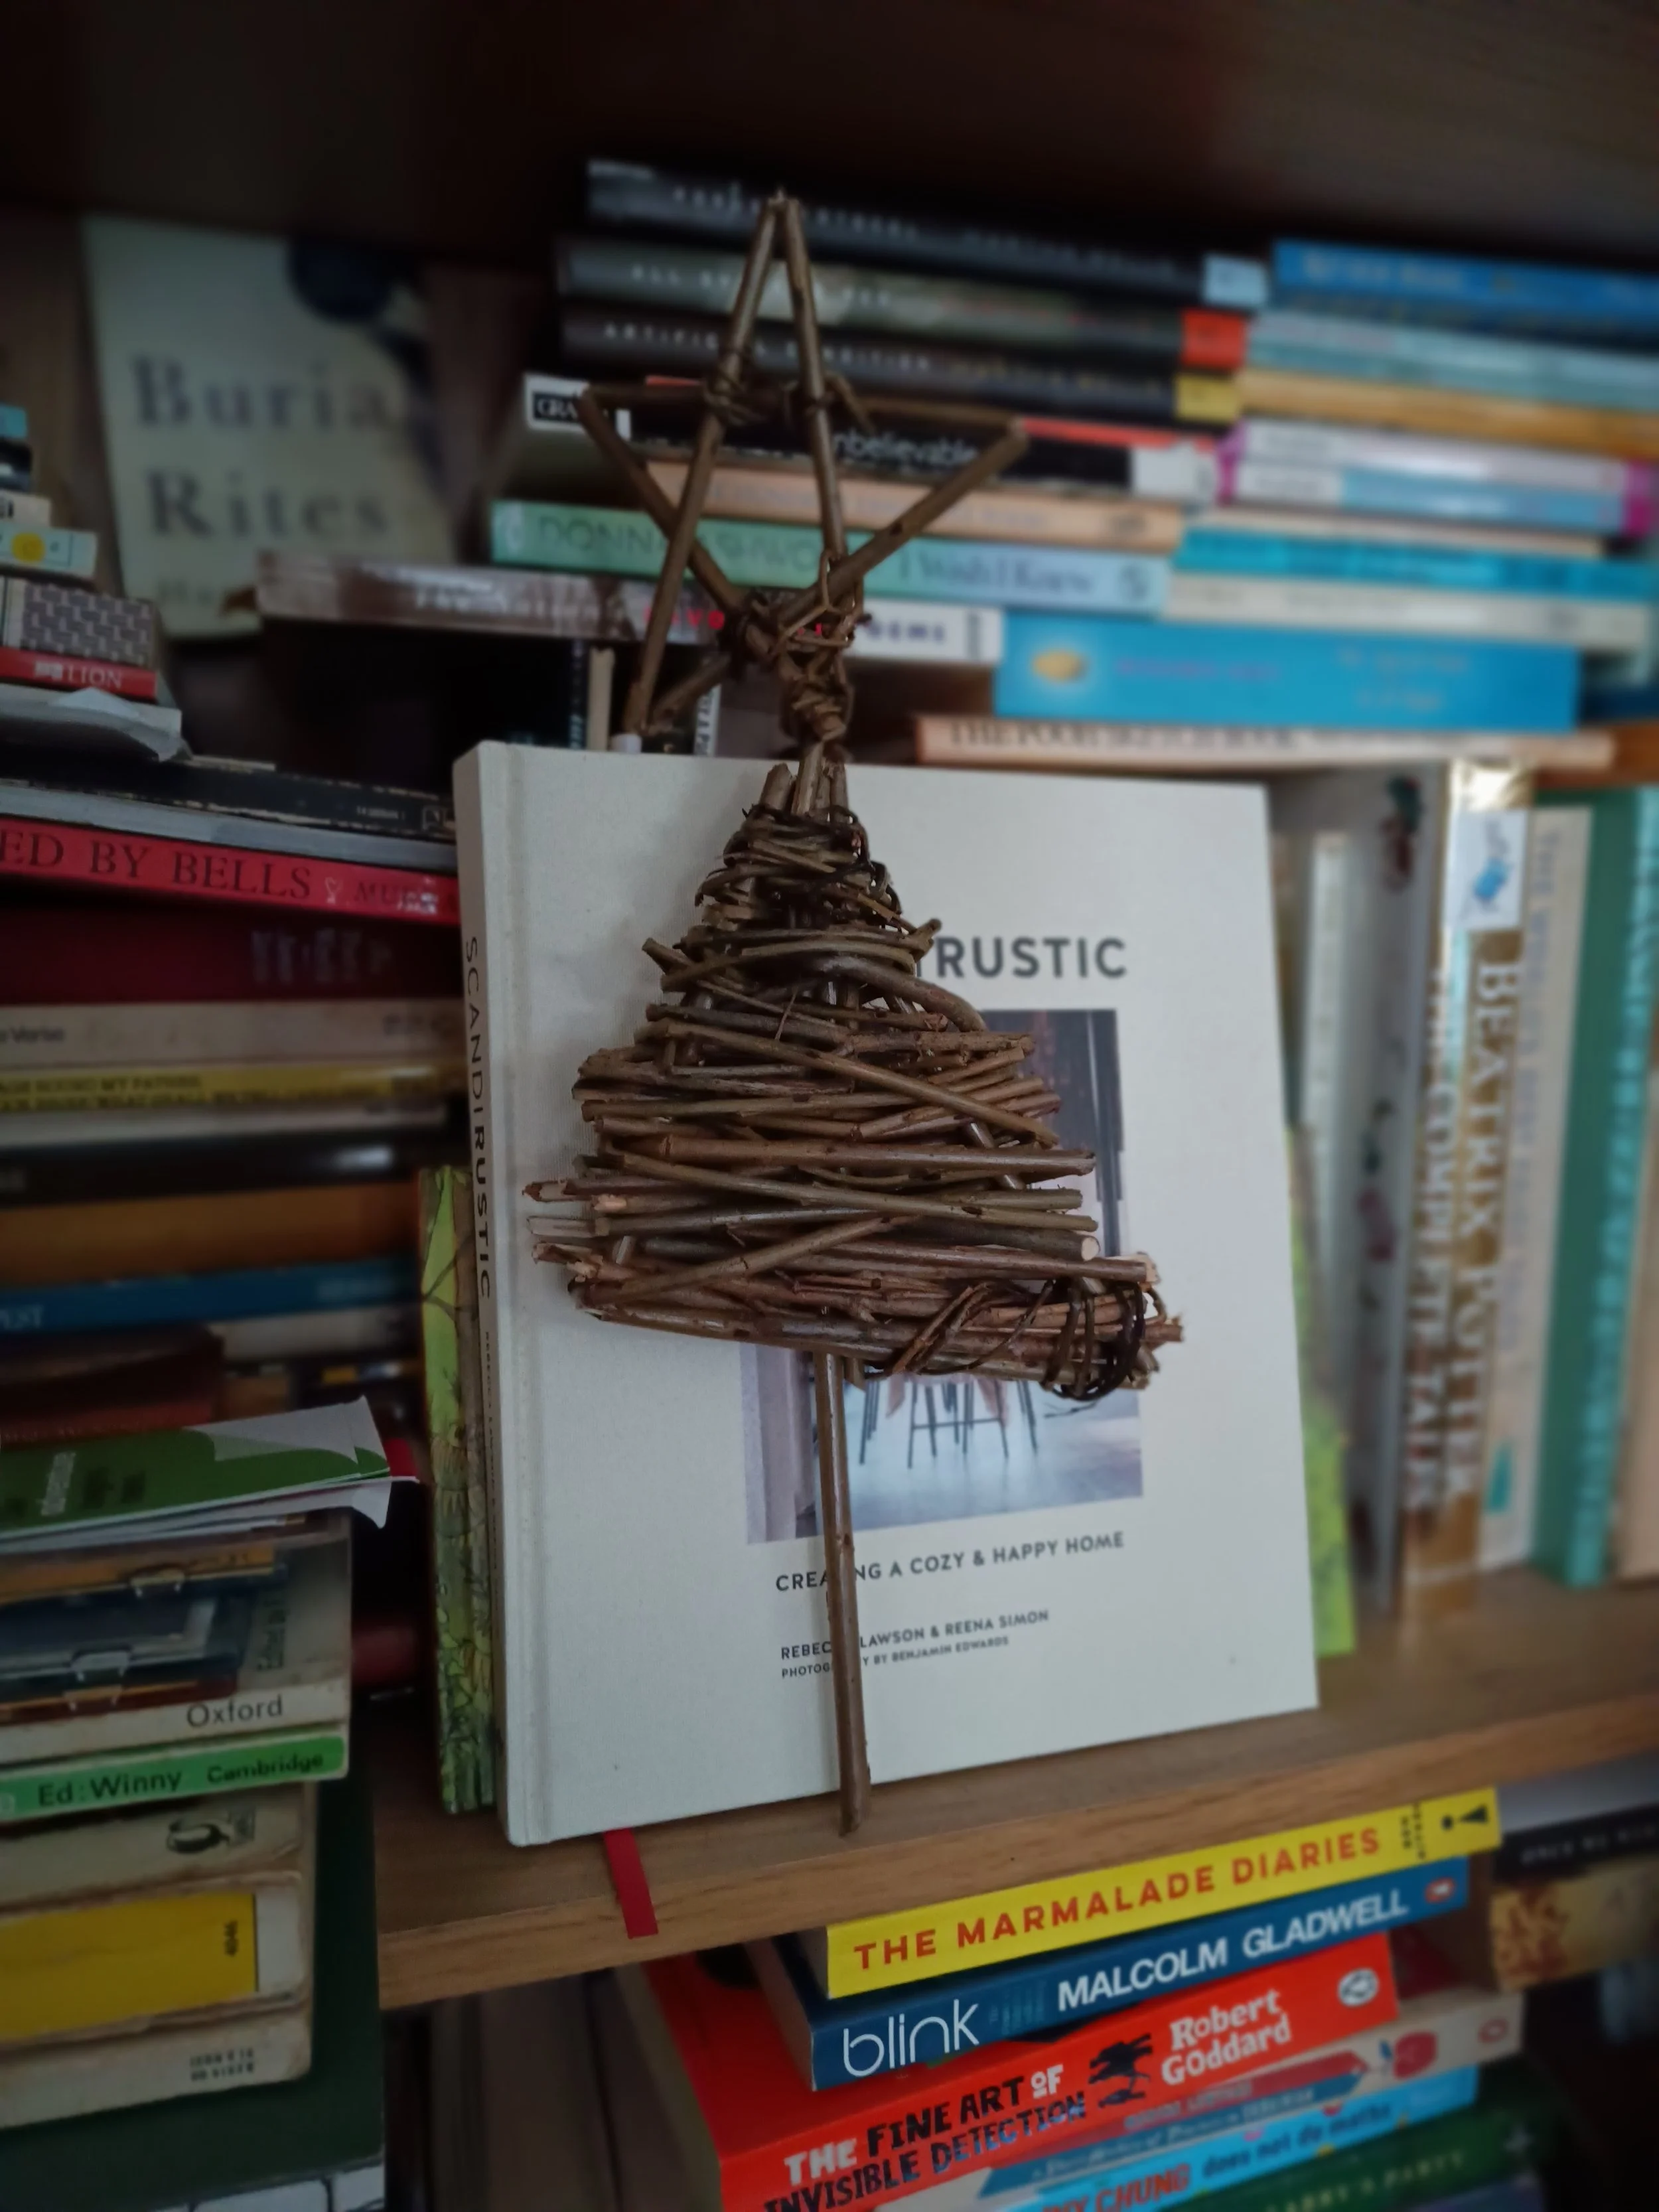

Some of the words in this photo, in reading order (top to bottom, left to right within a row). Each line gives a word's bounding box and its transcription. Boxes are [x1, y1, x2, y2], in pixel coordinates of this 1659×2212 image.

[131, 354, 396, 431] Buria
[0, 827, 64, 867] ED
[89, 838, 150, 879] BY
[173, 855, 312, 900] BELLS
[775, 1562, 883, 1593] CREANG
[889, 1560, 903, 1578] A
[910, 1552, 966, 1576] COZY
[972, 1549, 985, 1568] &
[993, 1540, 1059, 1564] HAPPY
[1065, 1531, 1124, 1555] HOME
[781, 1641, 832, 1660] REBEC
[859, 1627, 925, 1649] LAWSON
[930, 1625, 940, 1638] &
[944, 1618, 994, 1637] REENA
[998, 1609, 1049, 1629] SIMON
[781, 1656, 870, 1679] PHOTOGY
[873, 1653, 888, 1666] BY
[186, 1694, 283, 1728] Oxford
[90, 1770, 182, 1801] Winny
[207, 1752, 324, 1784] Cambridge
[854, 1927, 937, 1970] THE
[958, 1864, 1216, 1949] MARMALADE
[1232, 1826, 1380, 1885] DIARIES
[843, 1999, 980, 2078] blink
[1058, 1936, 1229, 2012] MALCOLM
[1242, 1888, 1410, 1959] GLADWELL
[1169, 1988, 1282, 2052] Robert
[784, 2138, 858, 2186] THE
[867, 2101, 953, 2158] FINE
[960, 2075, 1025, 2125] ART
[931, 2091, 1087, 2175] DETECTION
